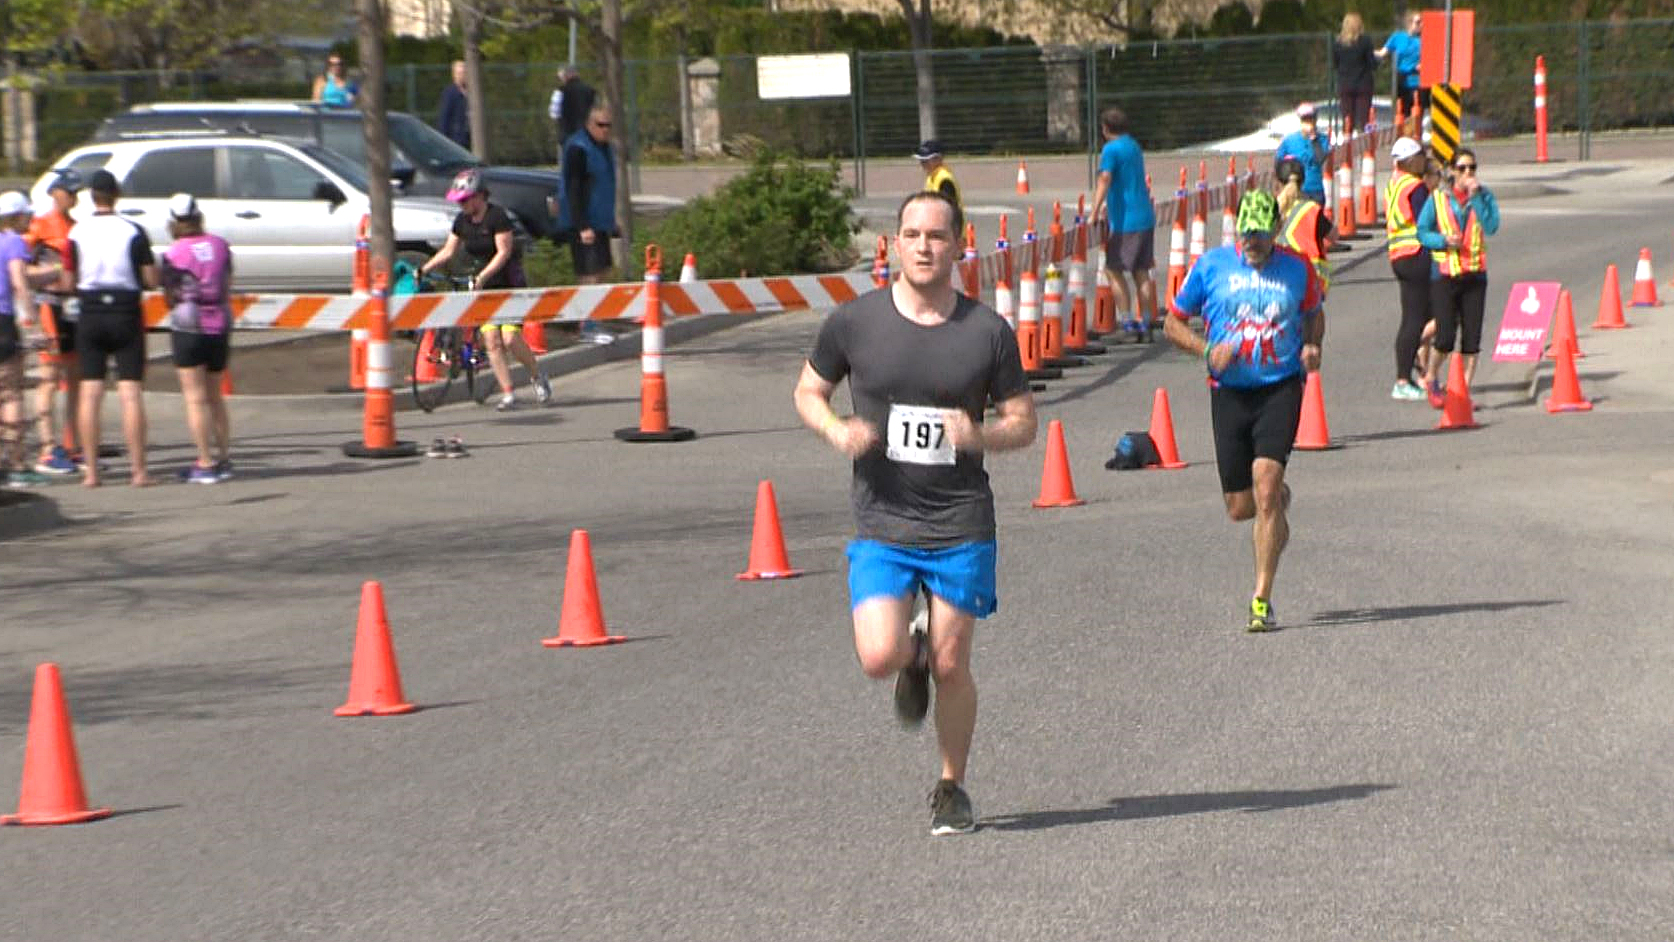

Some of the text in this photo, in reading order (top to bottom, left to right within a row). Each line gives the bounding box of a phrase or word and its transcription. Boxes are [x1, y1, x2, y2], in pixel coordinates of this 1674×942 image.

[1500, 328, 1543, 340] MOUNT
[1496, 343, 1529, 354] HERE
[902, 421, 945, 450] 197
